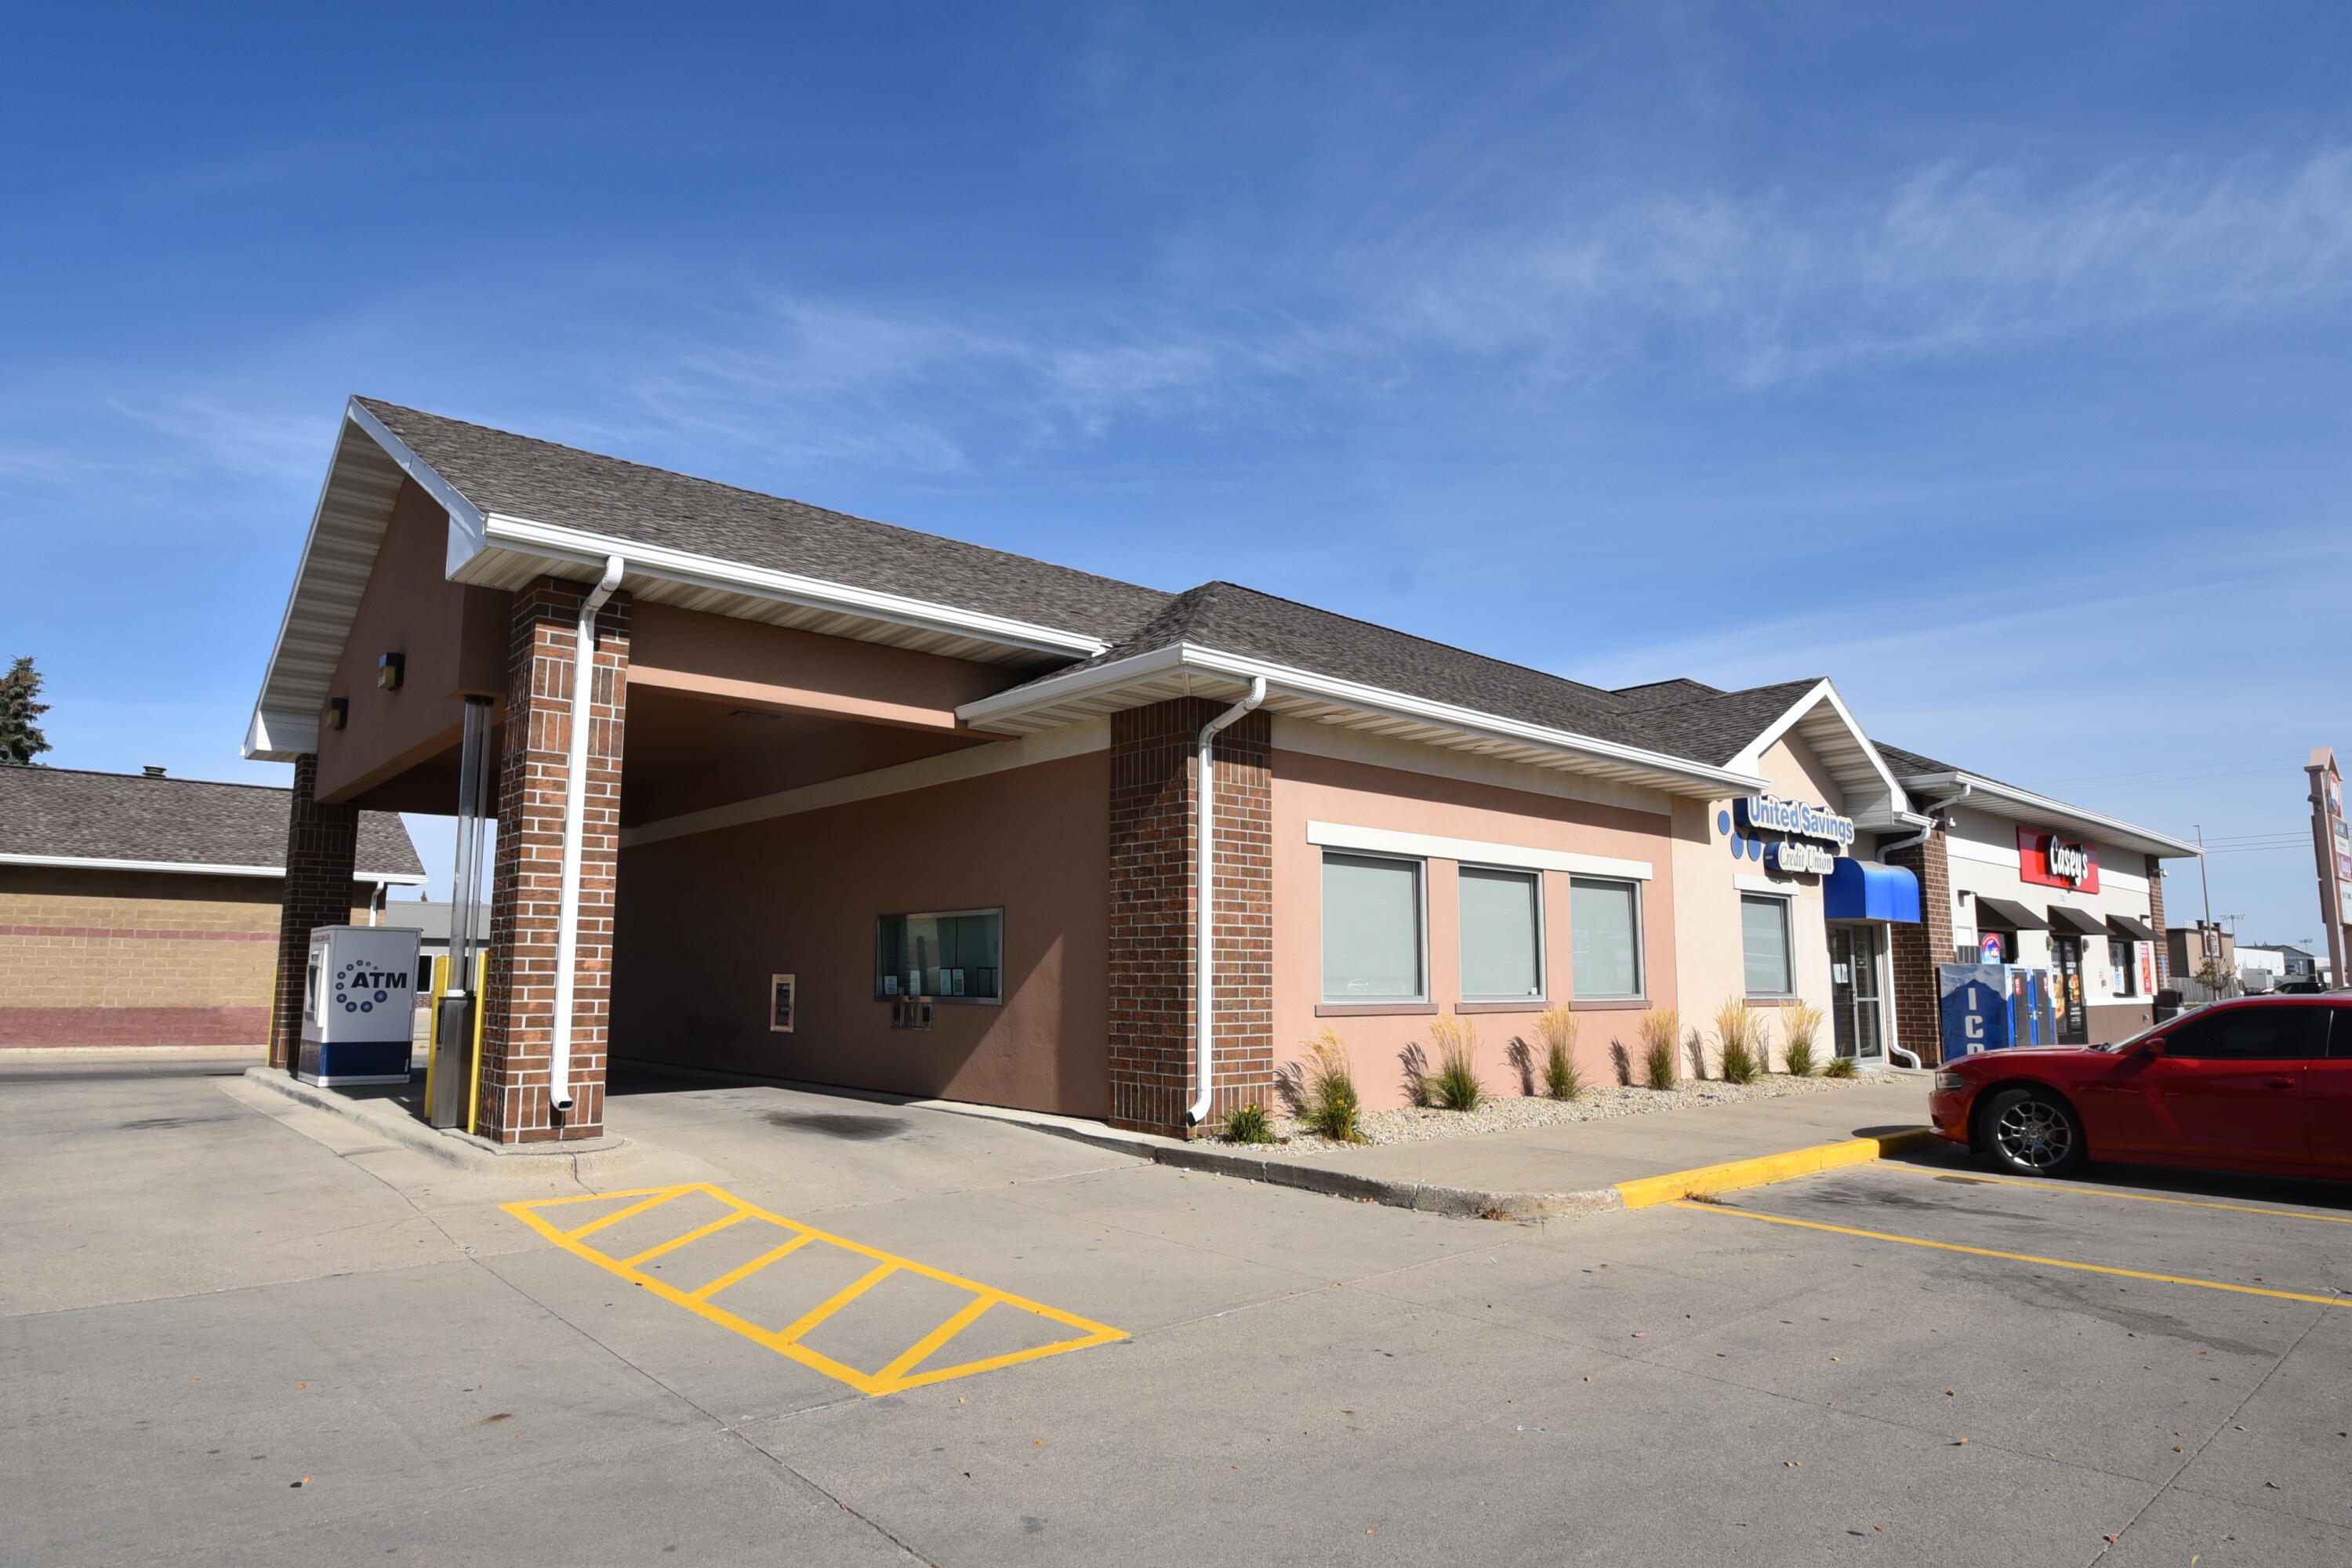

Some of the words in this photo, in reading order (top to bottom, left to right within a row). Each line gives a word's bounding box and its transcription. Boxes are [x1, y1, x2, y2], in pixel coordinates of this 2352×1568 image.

[1749, 796, 1800, 829] United
[1802, 806, 1853, 845] Savings
[1780, 845, 1804, 869] Credit
[1807, 849, 1831, 870] Union
[2049, 835, 2089, 887] Casey's
[351, 972, 408, 989] ATM
